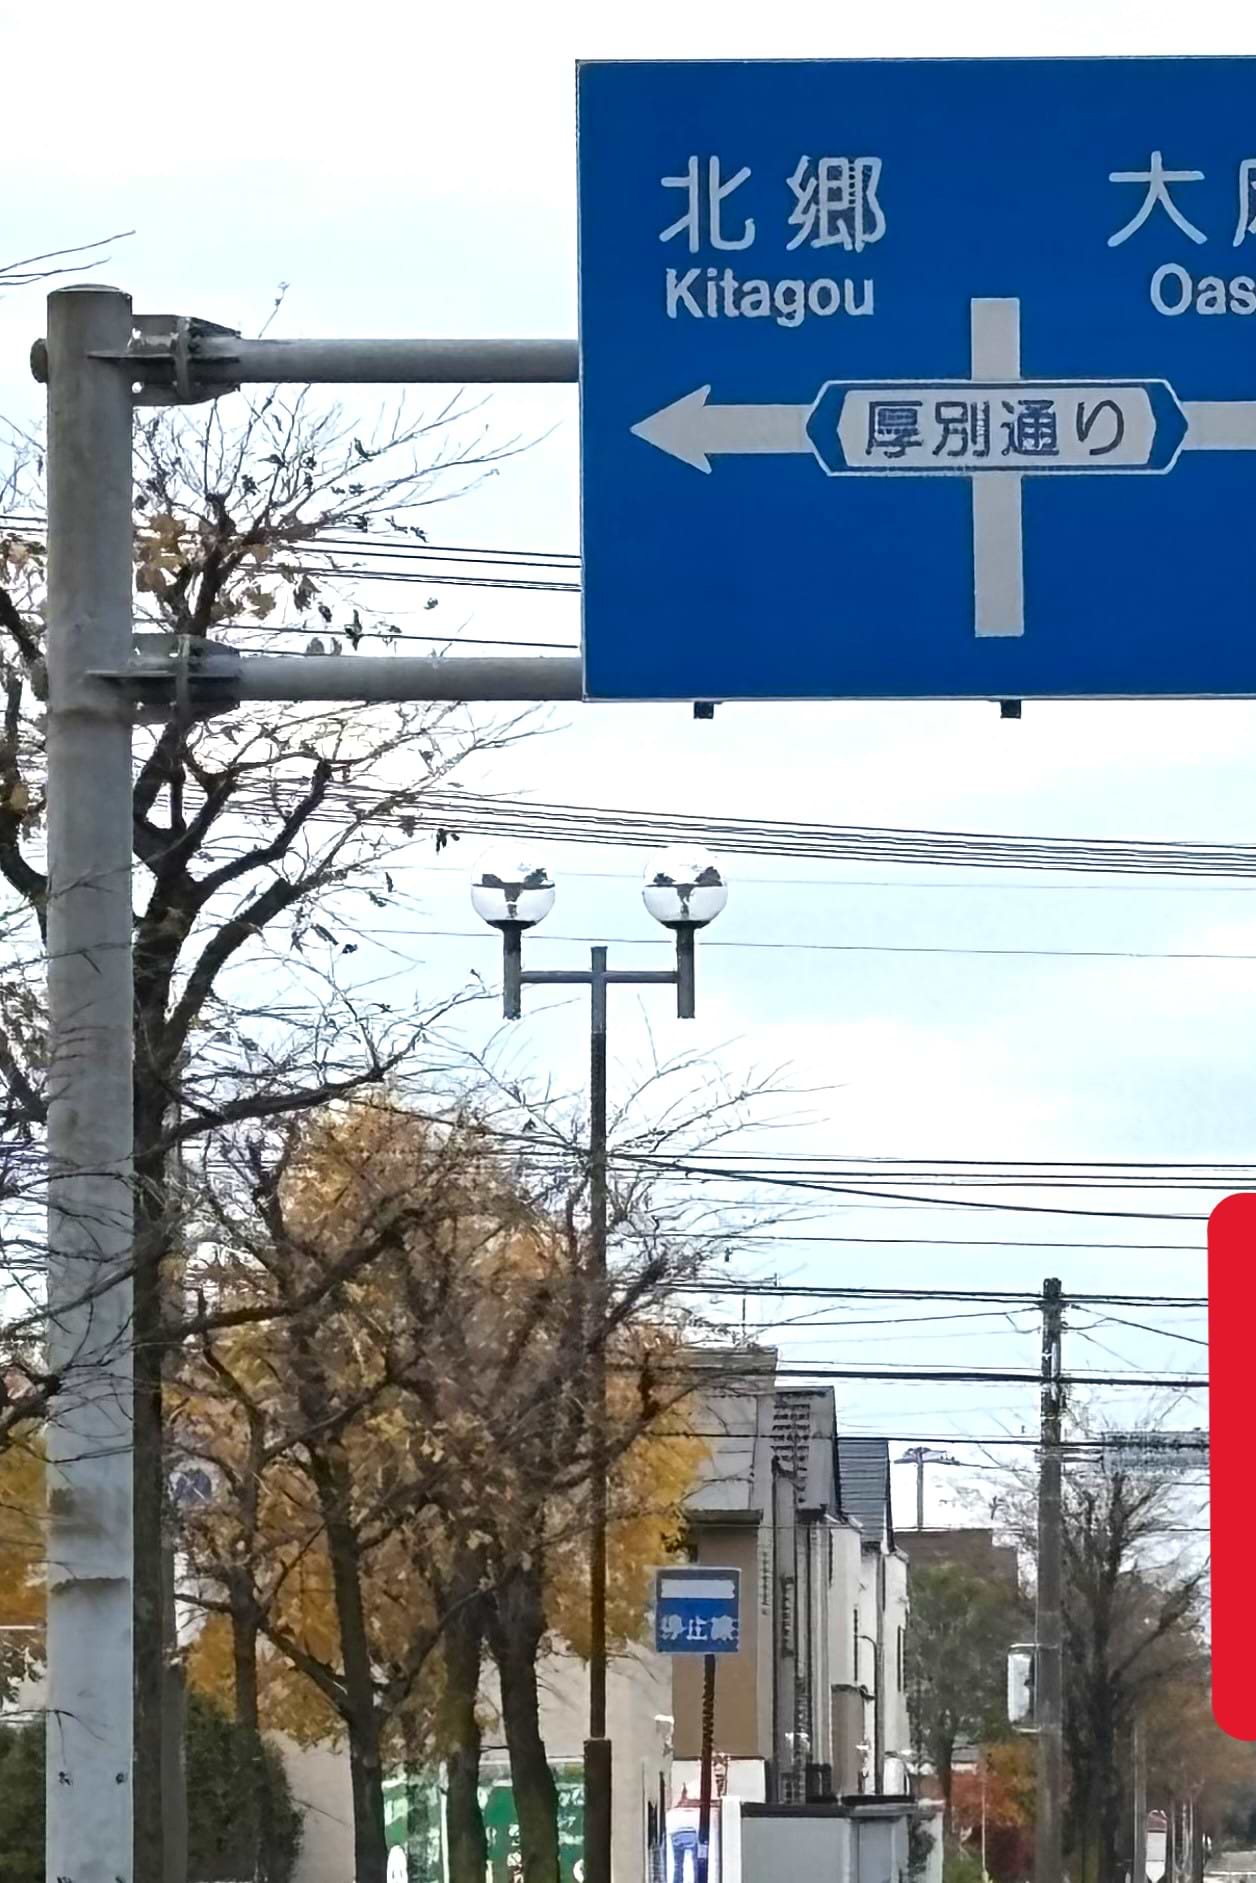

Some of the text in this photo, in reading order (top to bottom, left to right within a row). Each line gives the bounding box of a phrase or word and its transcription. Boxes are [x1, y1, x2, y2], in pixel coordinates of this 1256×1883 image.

[660, 156, 885, 252] 北郷
[666, 268, 875, 327] Kitagou
[865, 400, 1124, 459] 厚別通り
